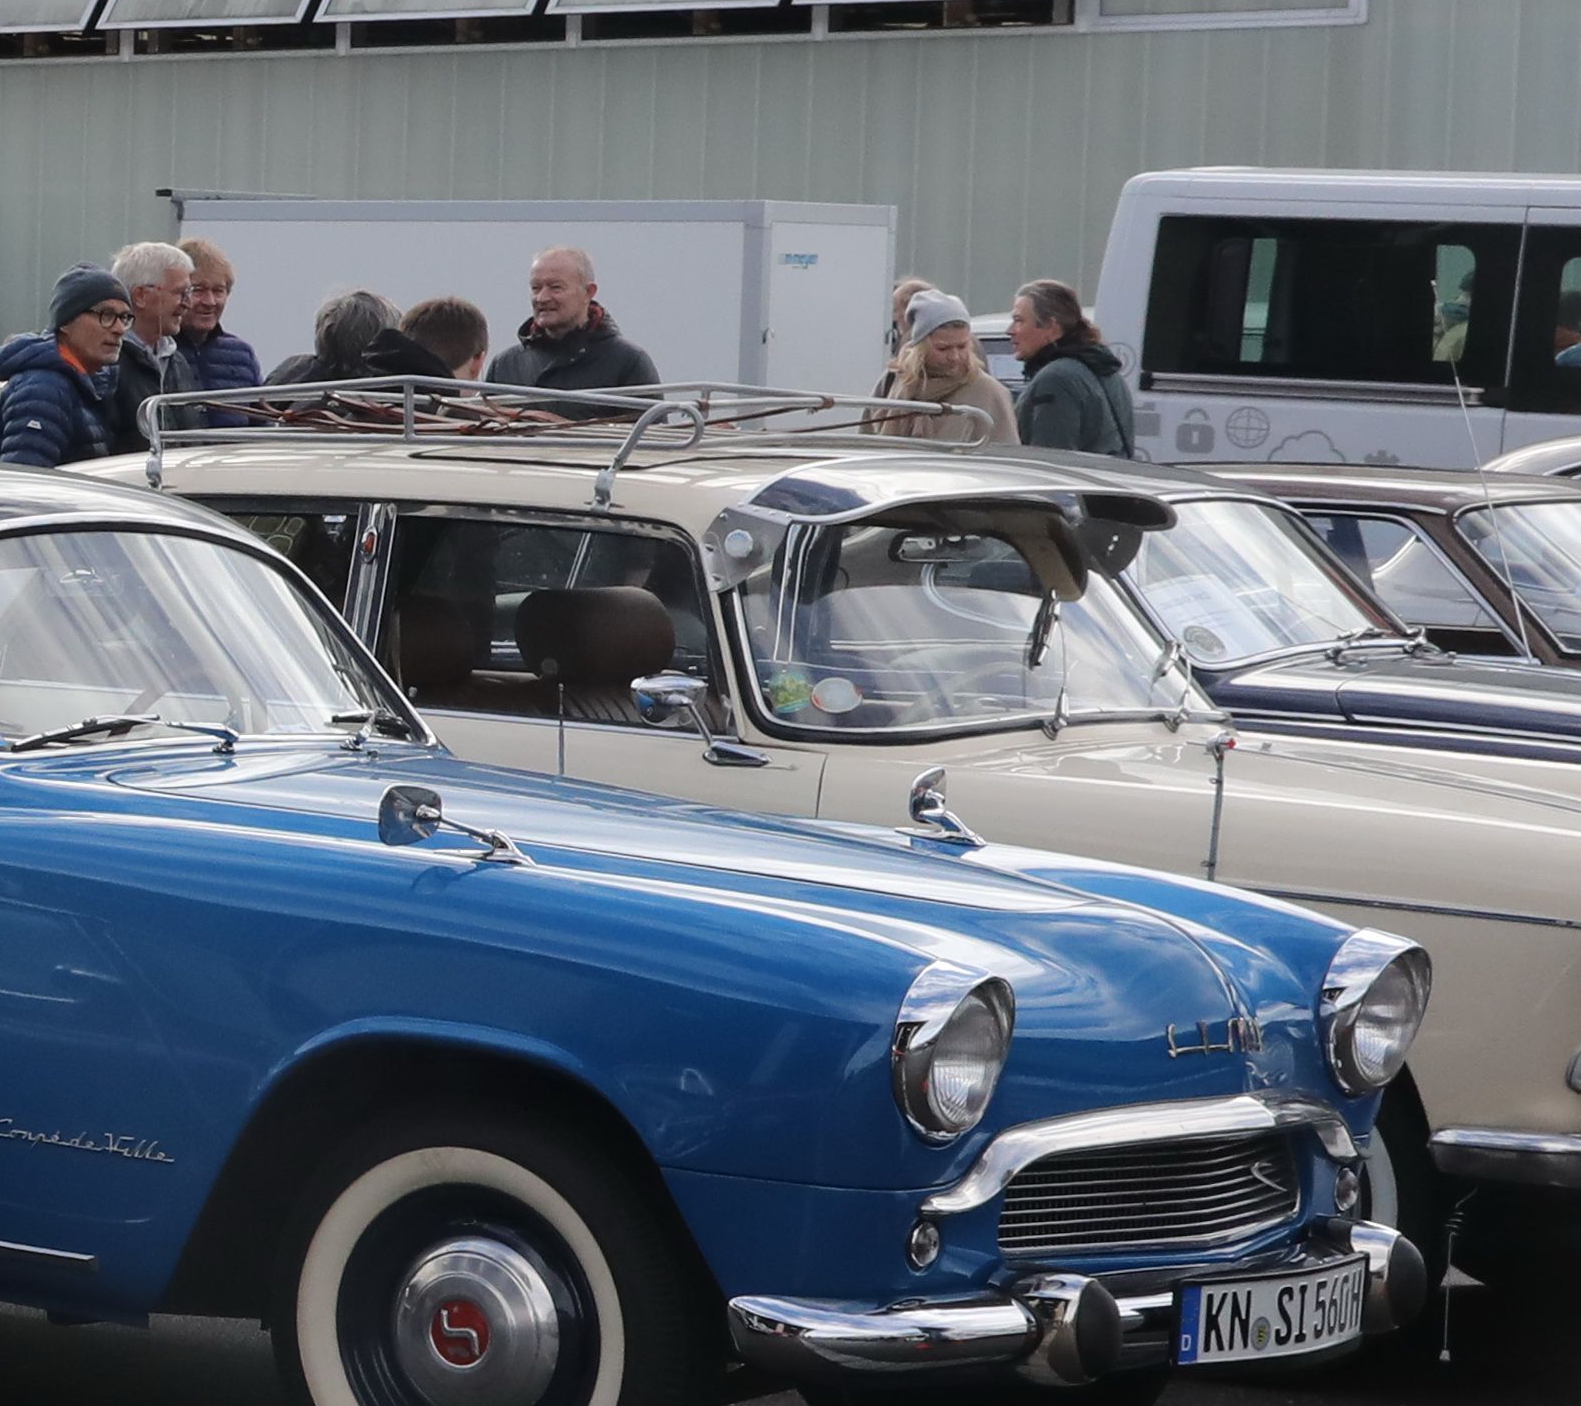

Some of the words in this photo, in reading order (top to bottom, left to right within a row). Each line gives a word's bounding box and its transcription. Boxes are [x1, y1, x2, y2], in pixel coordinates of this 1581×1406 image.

[103, 1132, 175, 1163] Ville
[1203, 1289, 1252, 1353] KN
[1274, 1282, 1309, 1346] SI
[1313, 1268, 1363, 1340] 560H
[1181, 1334, 1192, 1352] D
